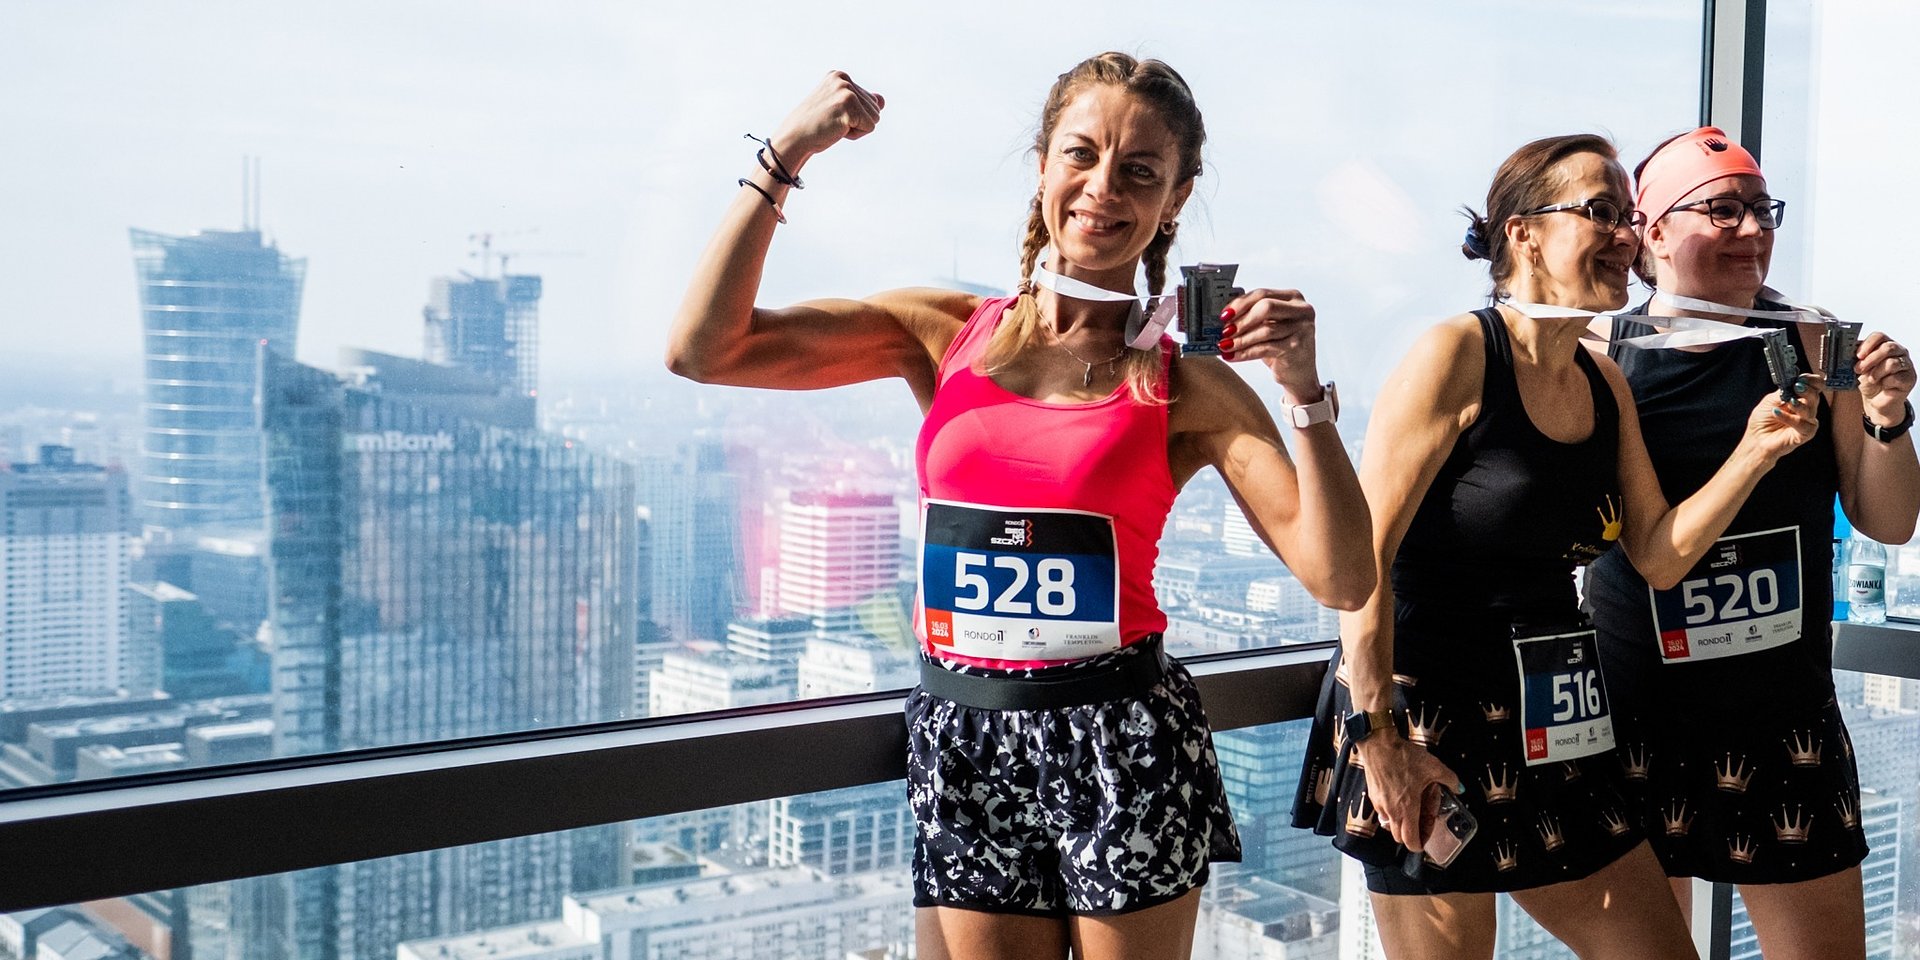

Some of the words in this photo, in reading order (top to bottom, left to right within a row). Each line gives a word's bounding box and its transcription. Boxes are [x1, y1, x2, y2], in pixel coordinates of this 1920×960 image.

[357, 430, 454, 451] mBank
[991, 537, 1025, 546] SZCZYT
[954, 551, 1076, 616] 528
[1682, 568, 1779, 625] 520
[931, 628, 949, 638] 2024
[1552, 669, 1601, 722] 516
